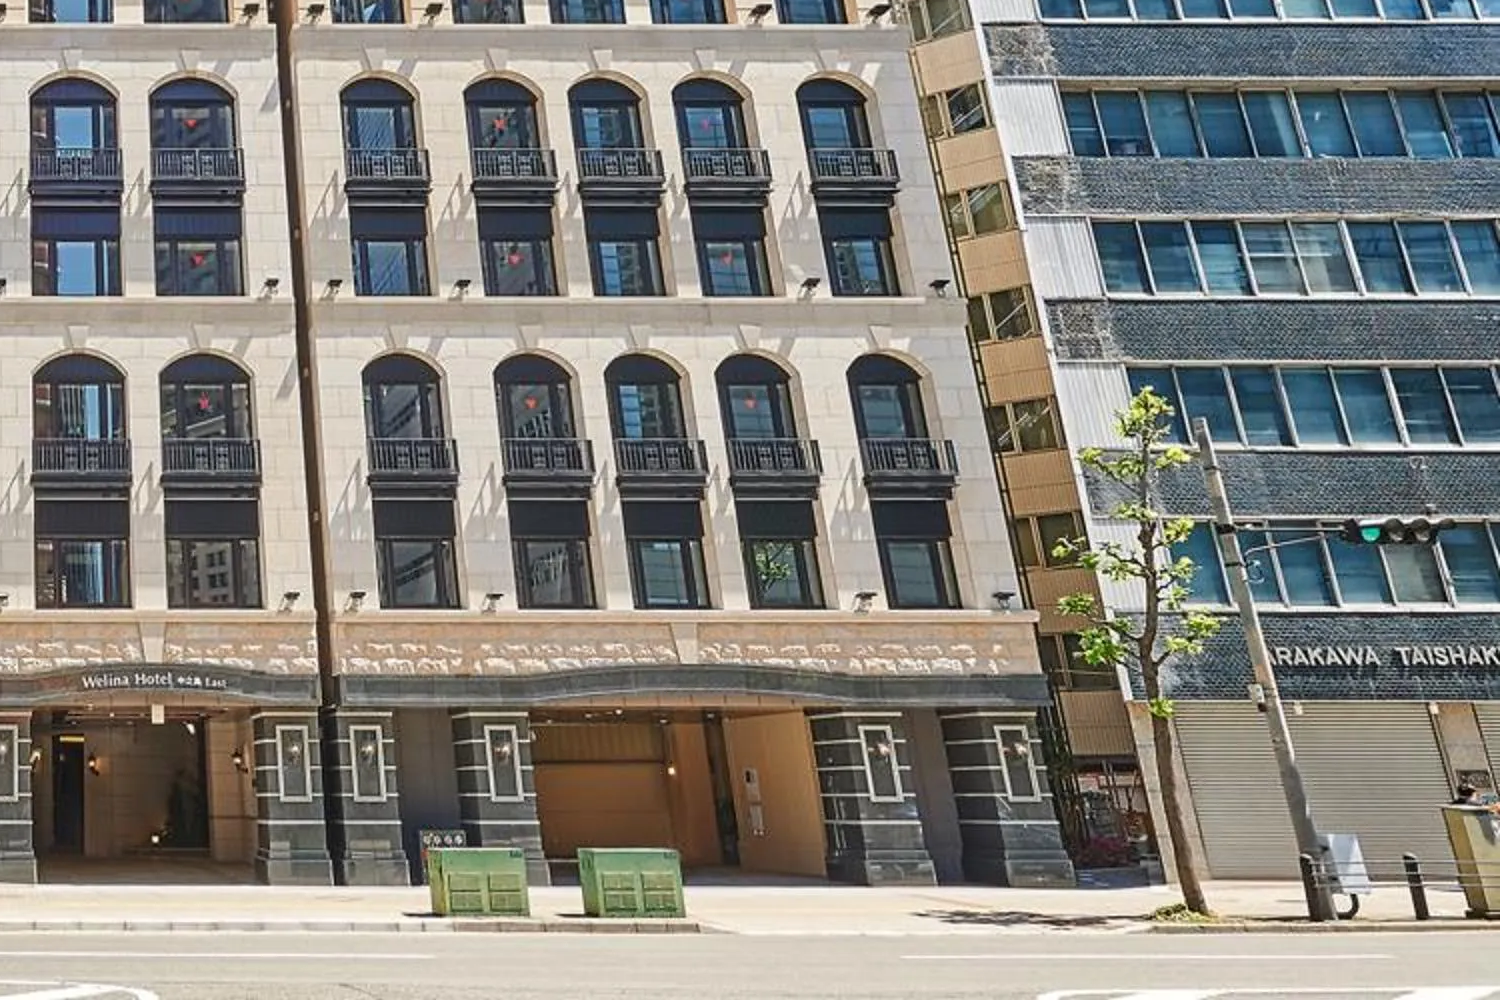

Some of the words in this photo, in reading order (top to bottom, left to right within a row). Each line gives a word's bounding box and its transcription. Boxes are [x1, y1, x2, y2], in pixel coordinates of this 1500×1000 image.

[1395, 646, 1500, 666] TAISHAK
[82, 673, 129, 688] Welina
[135, 672, 172, 687] Hotel
